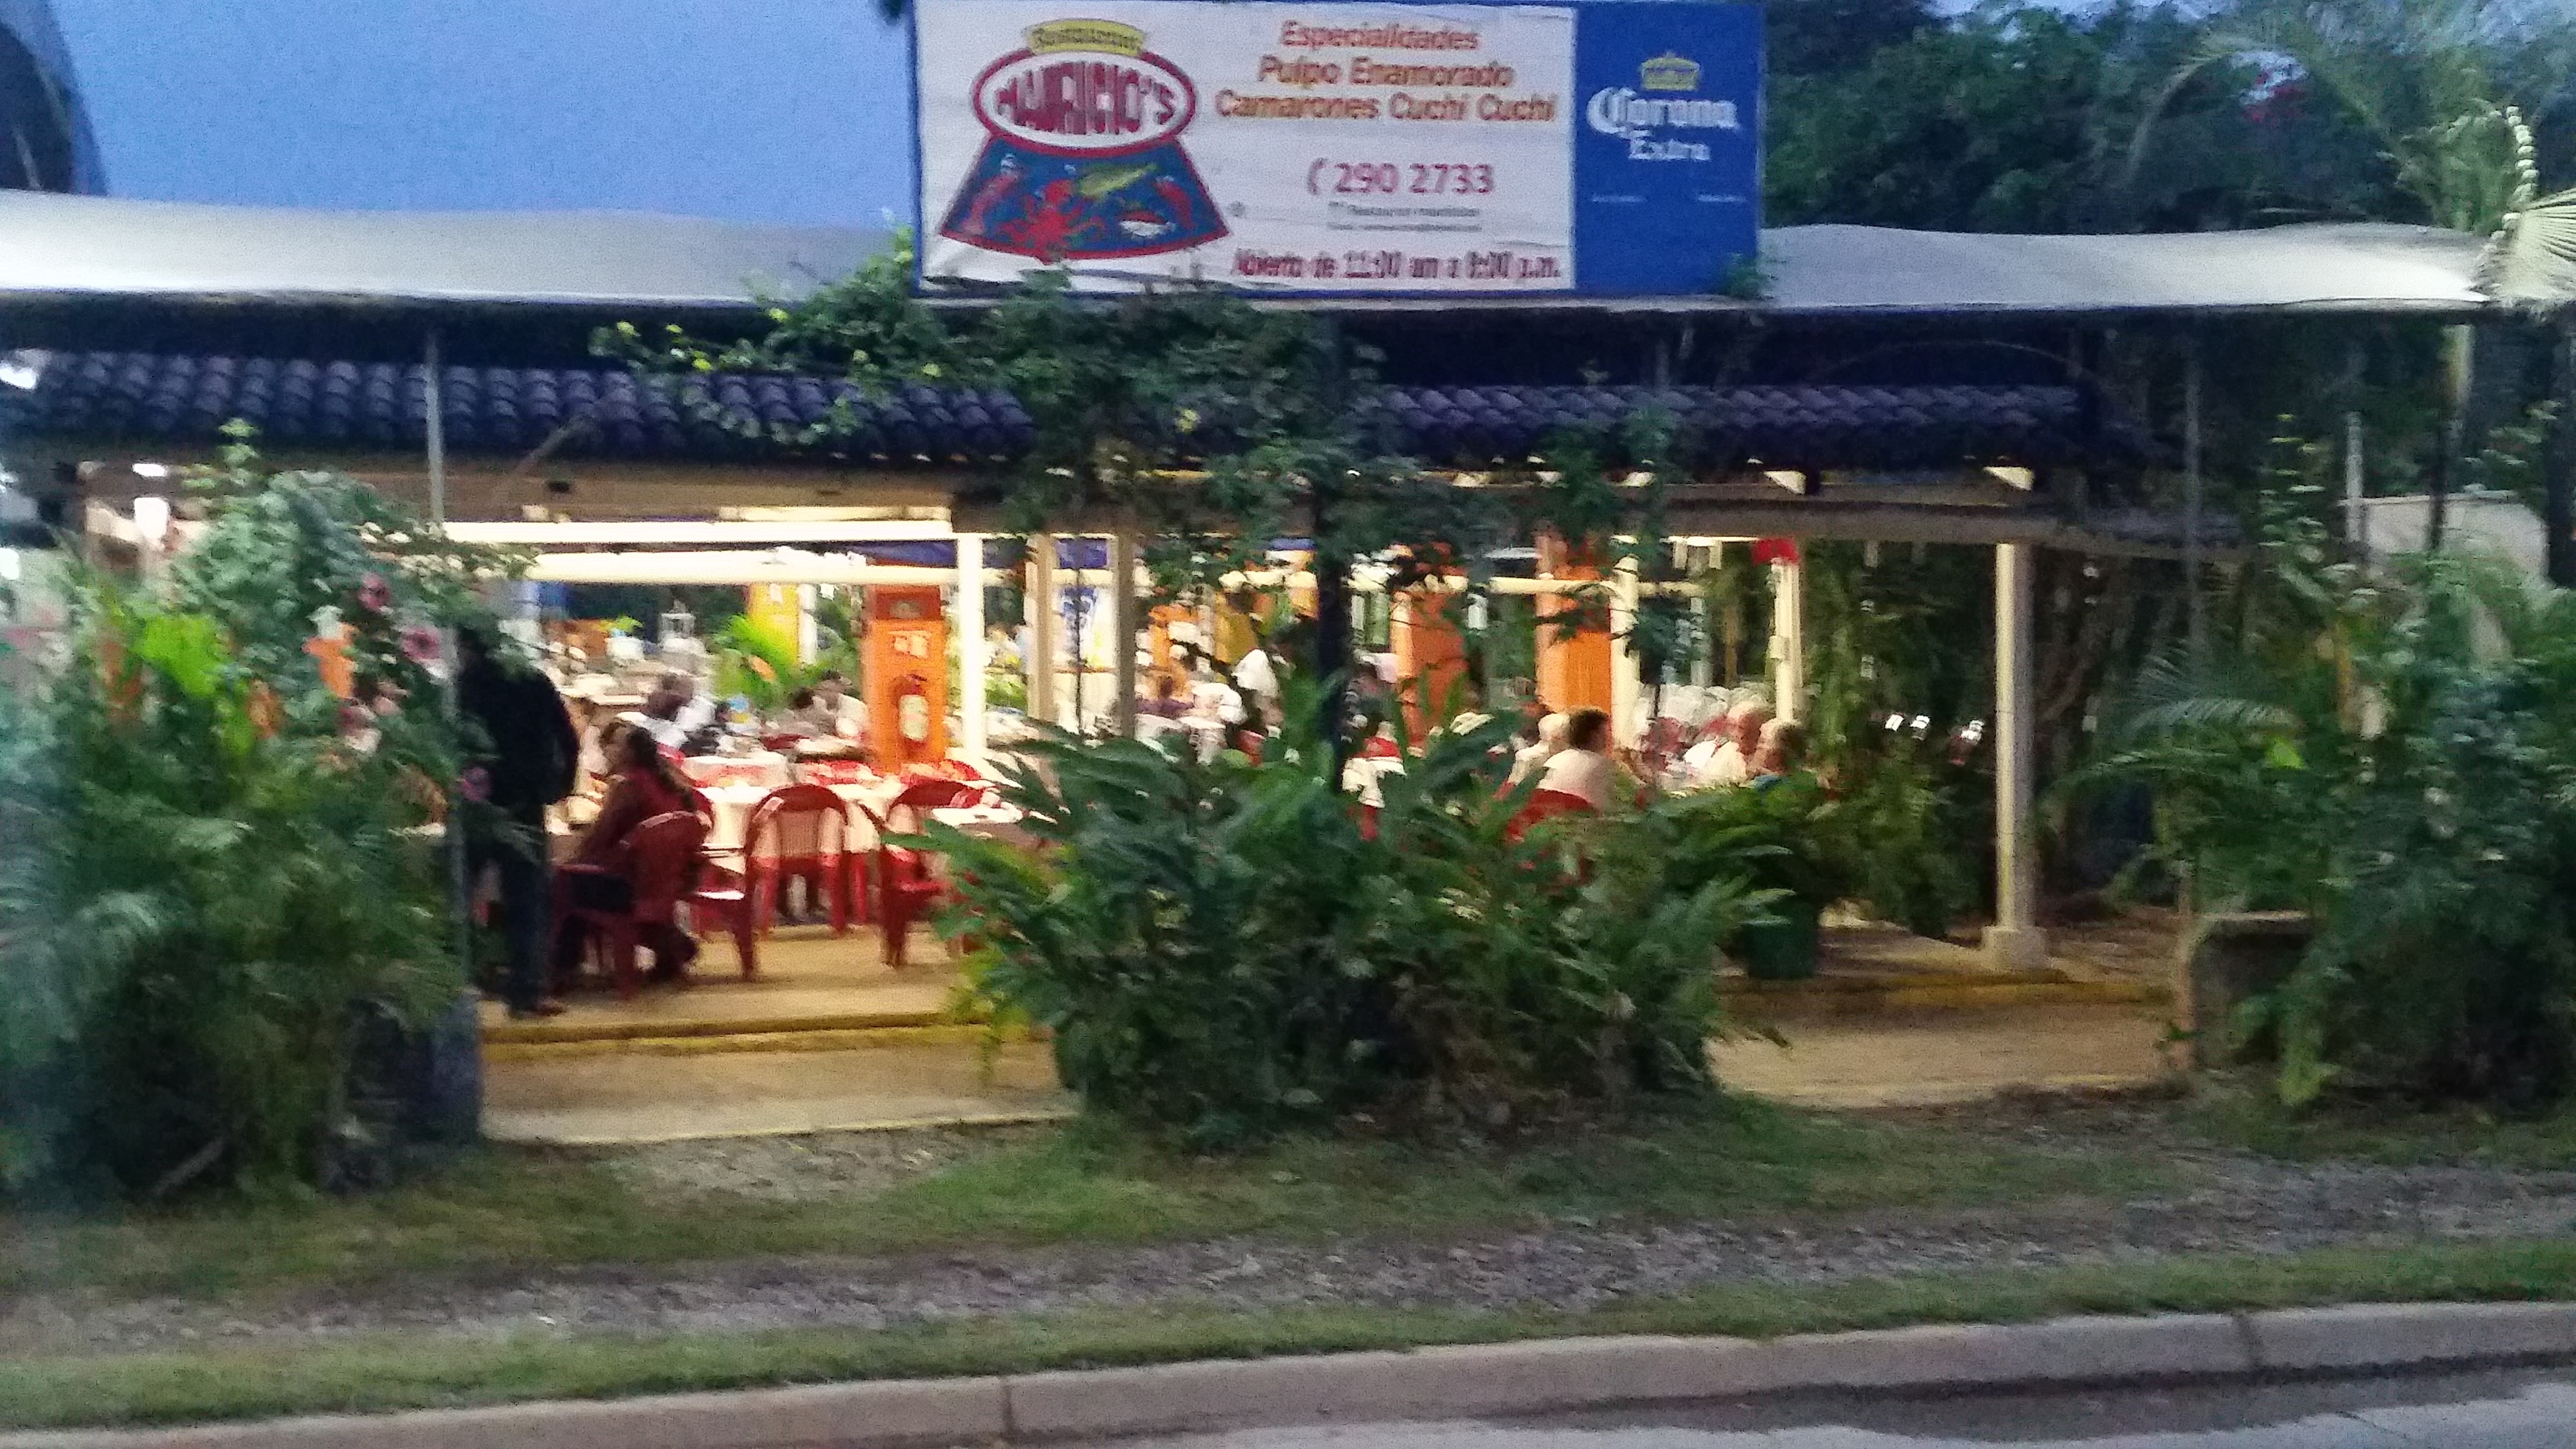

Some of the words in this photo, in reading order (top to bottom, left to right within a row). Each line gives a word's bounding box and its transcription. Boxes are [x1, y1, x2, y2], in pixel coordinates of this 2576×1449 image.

[1282, 19, 1480, 50] Especialidades
[1258, 55, 1341, 89] Pulpo
[1349, 56, 1514, 87] Enamorado
[1216, 90, 1380, 119] Camarones
[1587, 87, 1740, 141] Corona
[1628, 138, 1712, 162] Extra
[1409, 162, 1494, 194] 2733
[1313, 250, 1336, 278] de
[1447, 257, 1461, 279] a
